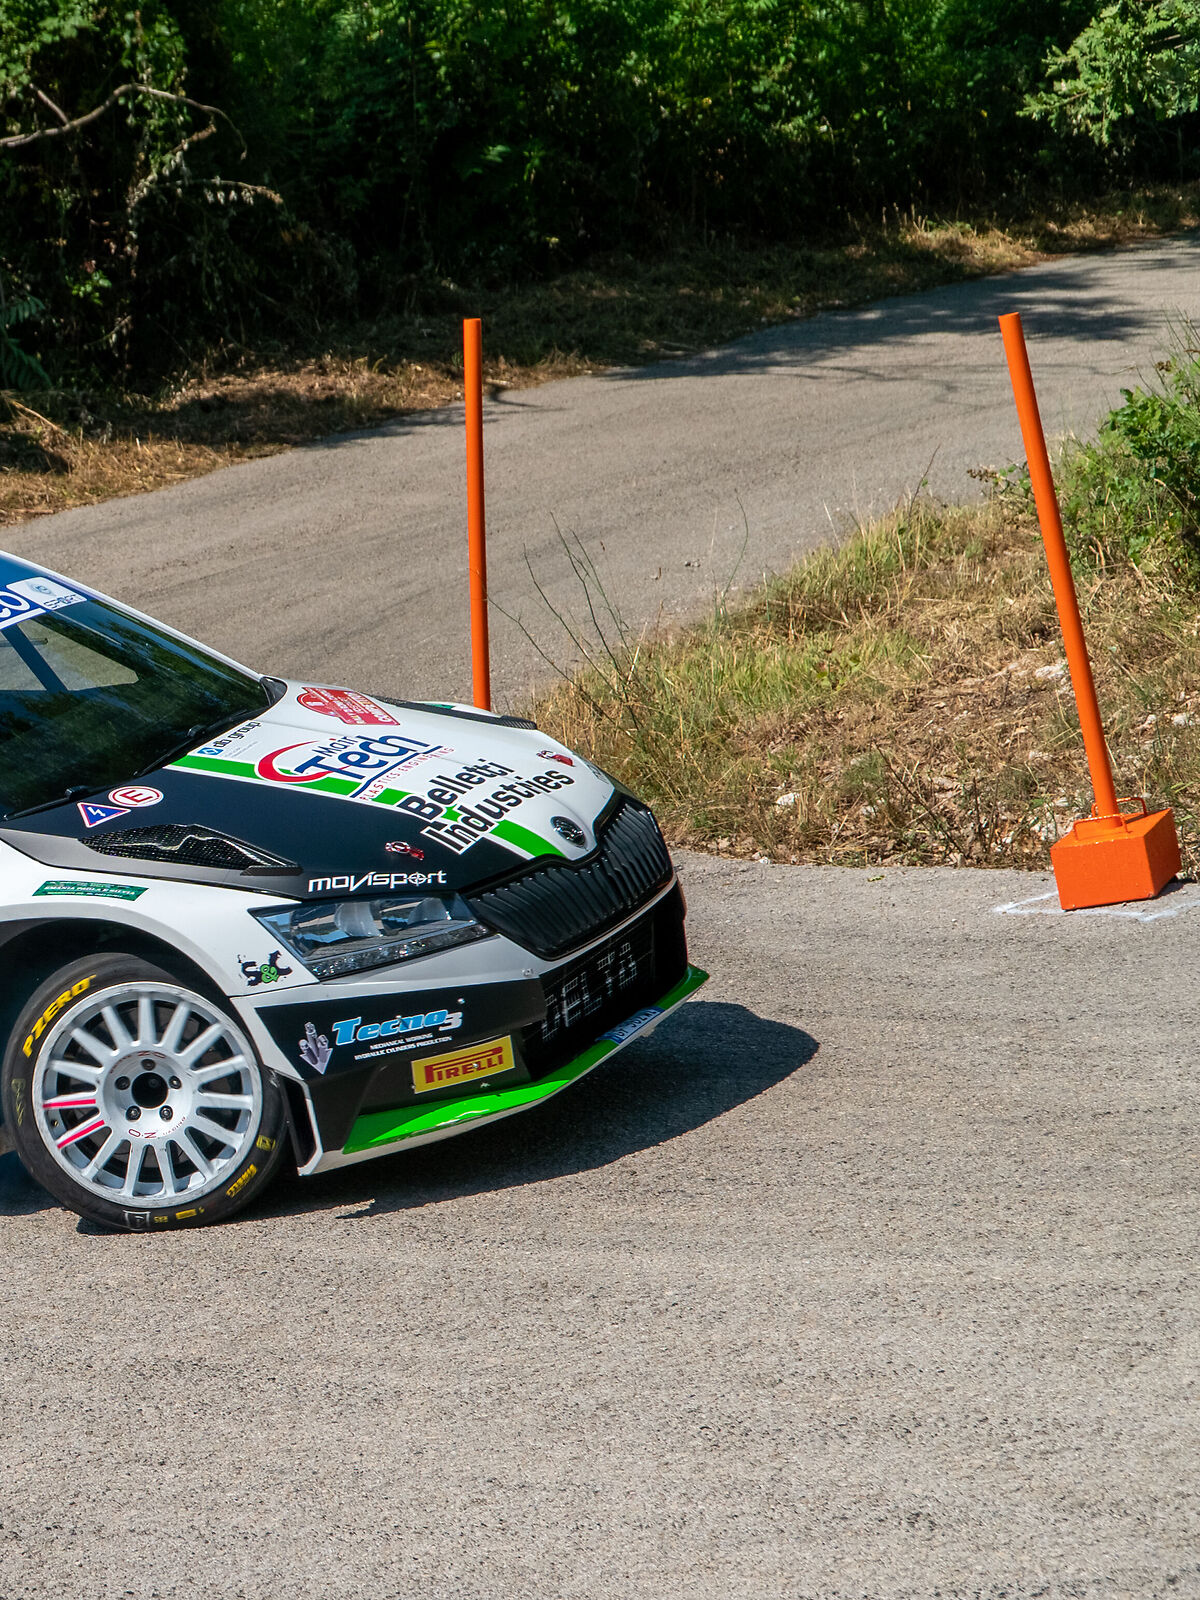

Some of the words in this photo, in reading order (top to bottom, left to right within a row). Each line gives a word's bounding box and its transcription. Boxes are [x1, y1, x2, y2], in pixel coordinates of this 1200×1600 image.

[294, 735, 431, 780] Tech
[359, 771, 401, 801] PLASTICS
[397, 758, 516, 821] Belletti
[421, 770, 576, 853] Industries
[308, 870, 447, 893] movisport
[369, 1038, 404, 1050] MECHANICAL
[424, 1046, 504, 1084] PIRELLI
